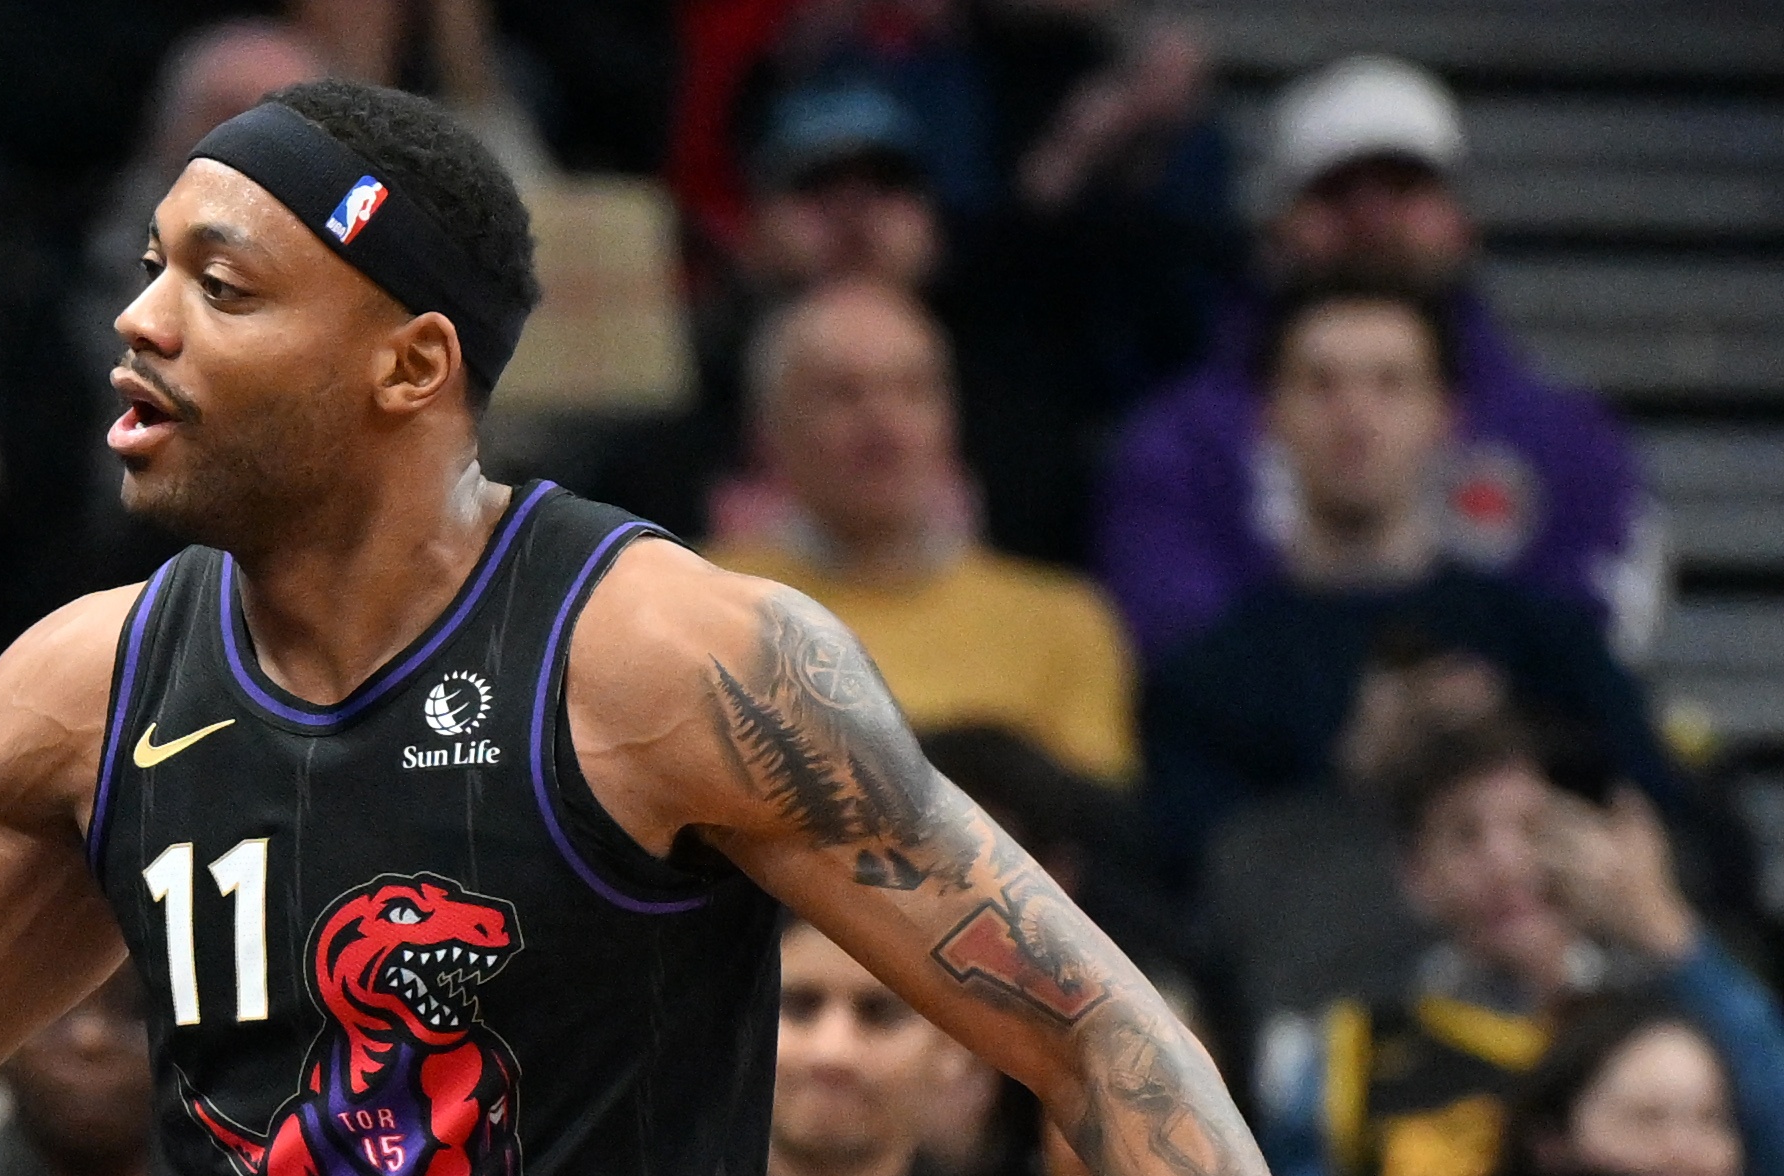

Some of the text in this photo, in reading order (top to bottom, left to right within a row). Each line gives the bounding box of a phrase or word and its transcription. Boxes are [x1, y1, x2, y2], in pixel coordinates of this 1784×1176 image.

[402, 739, 501, 769] Sun Life
[142, 837, 271, 1026] 11
[337, 1108, 396, 1132] TOR
[361, 1133, 406, 1172] 15
